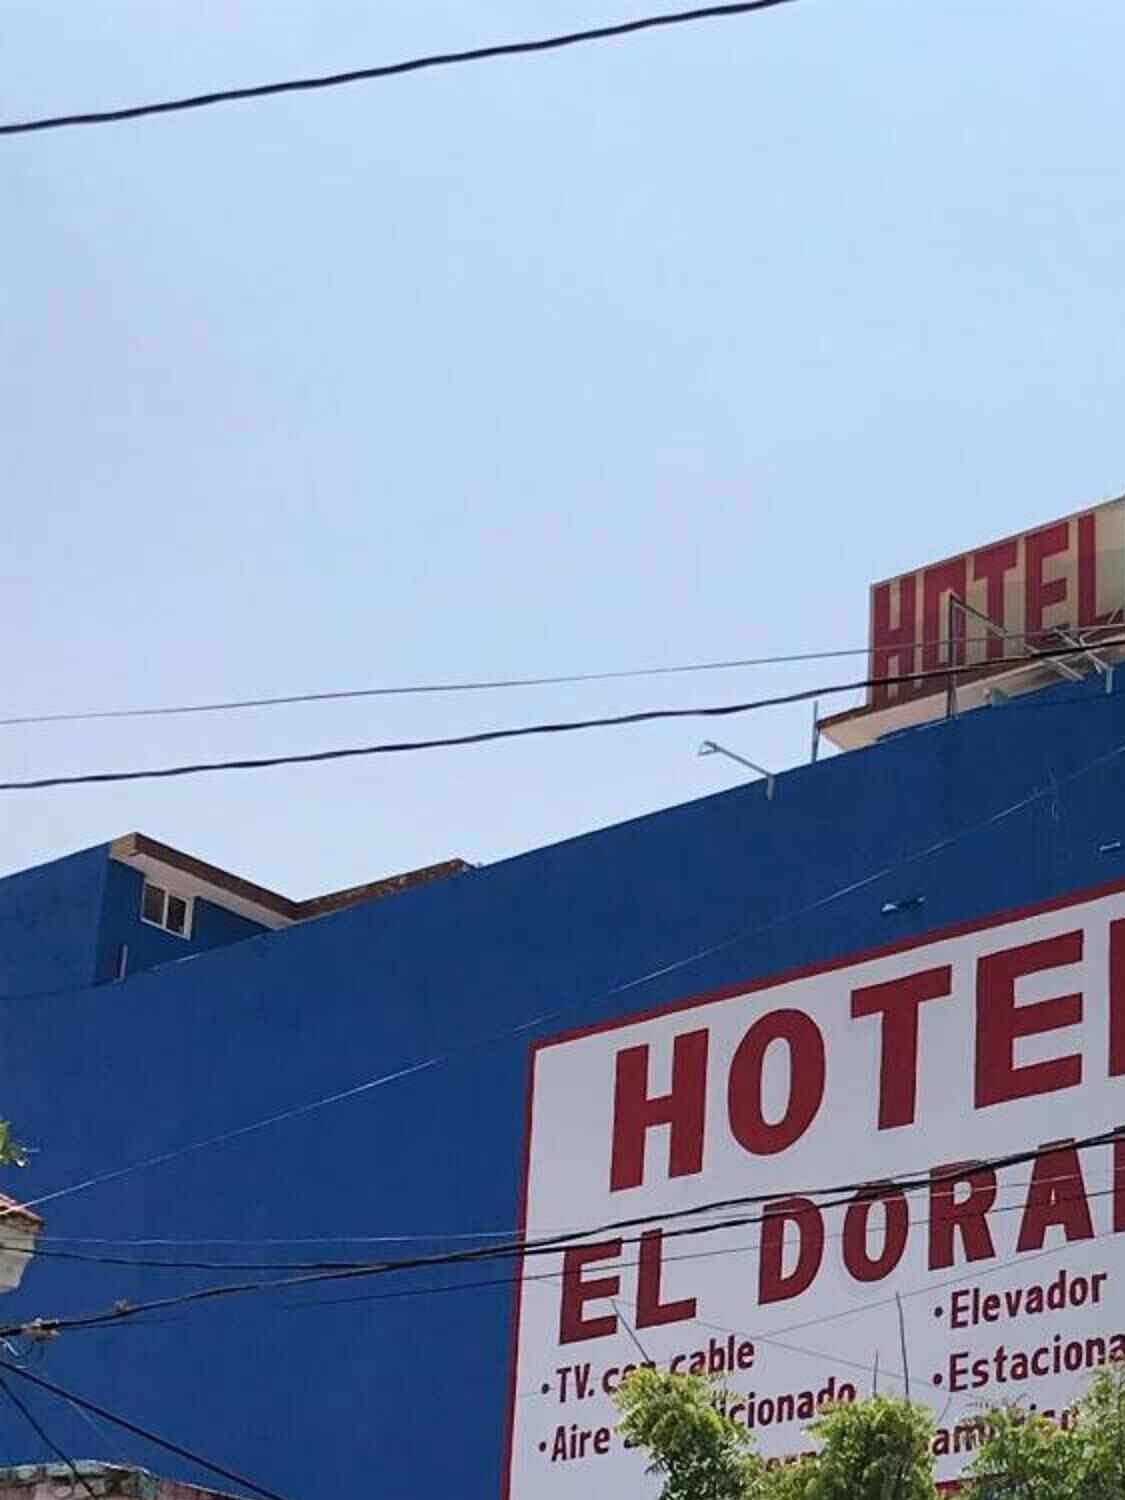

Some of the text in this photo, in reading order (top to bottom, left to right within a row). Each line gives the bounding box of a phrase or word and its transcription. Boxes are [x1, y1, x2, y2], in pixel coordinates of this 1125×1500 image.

[873, 512, 1124, 699] HOTEL
[559, 1228, 697, 1345] EL
[951, 1269, 1107, 1329] Elevador
[669, 1335, 755, 1376] cable
[551, 1423, 611, 1462] Aire
